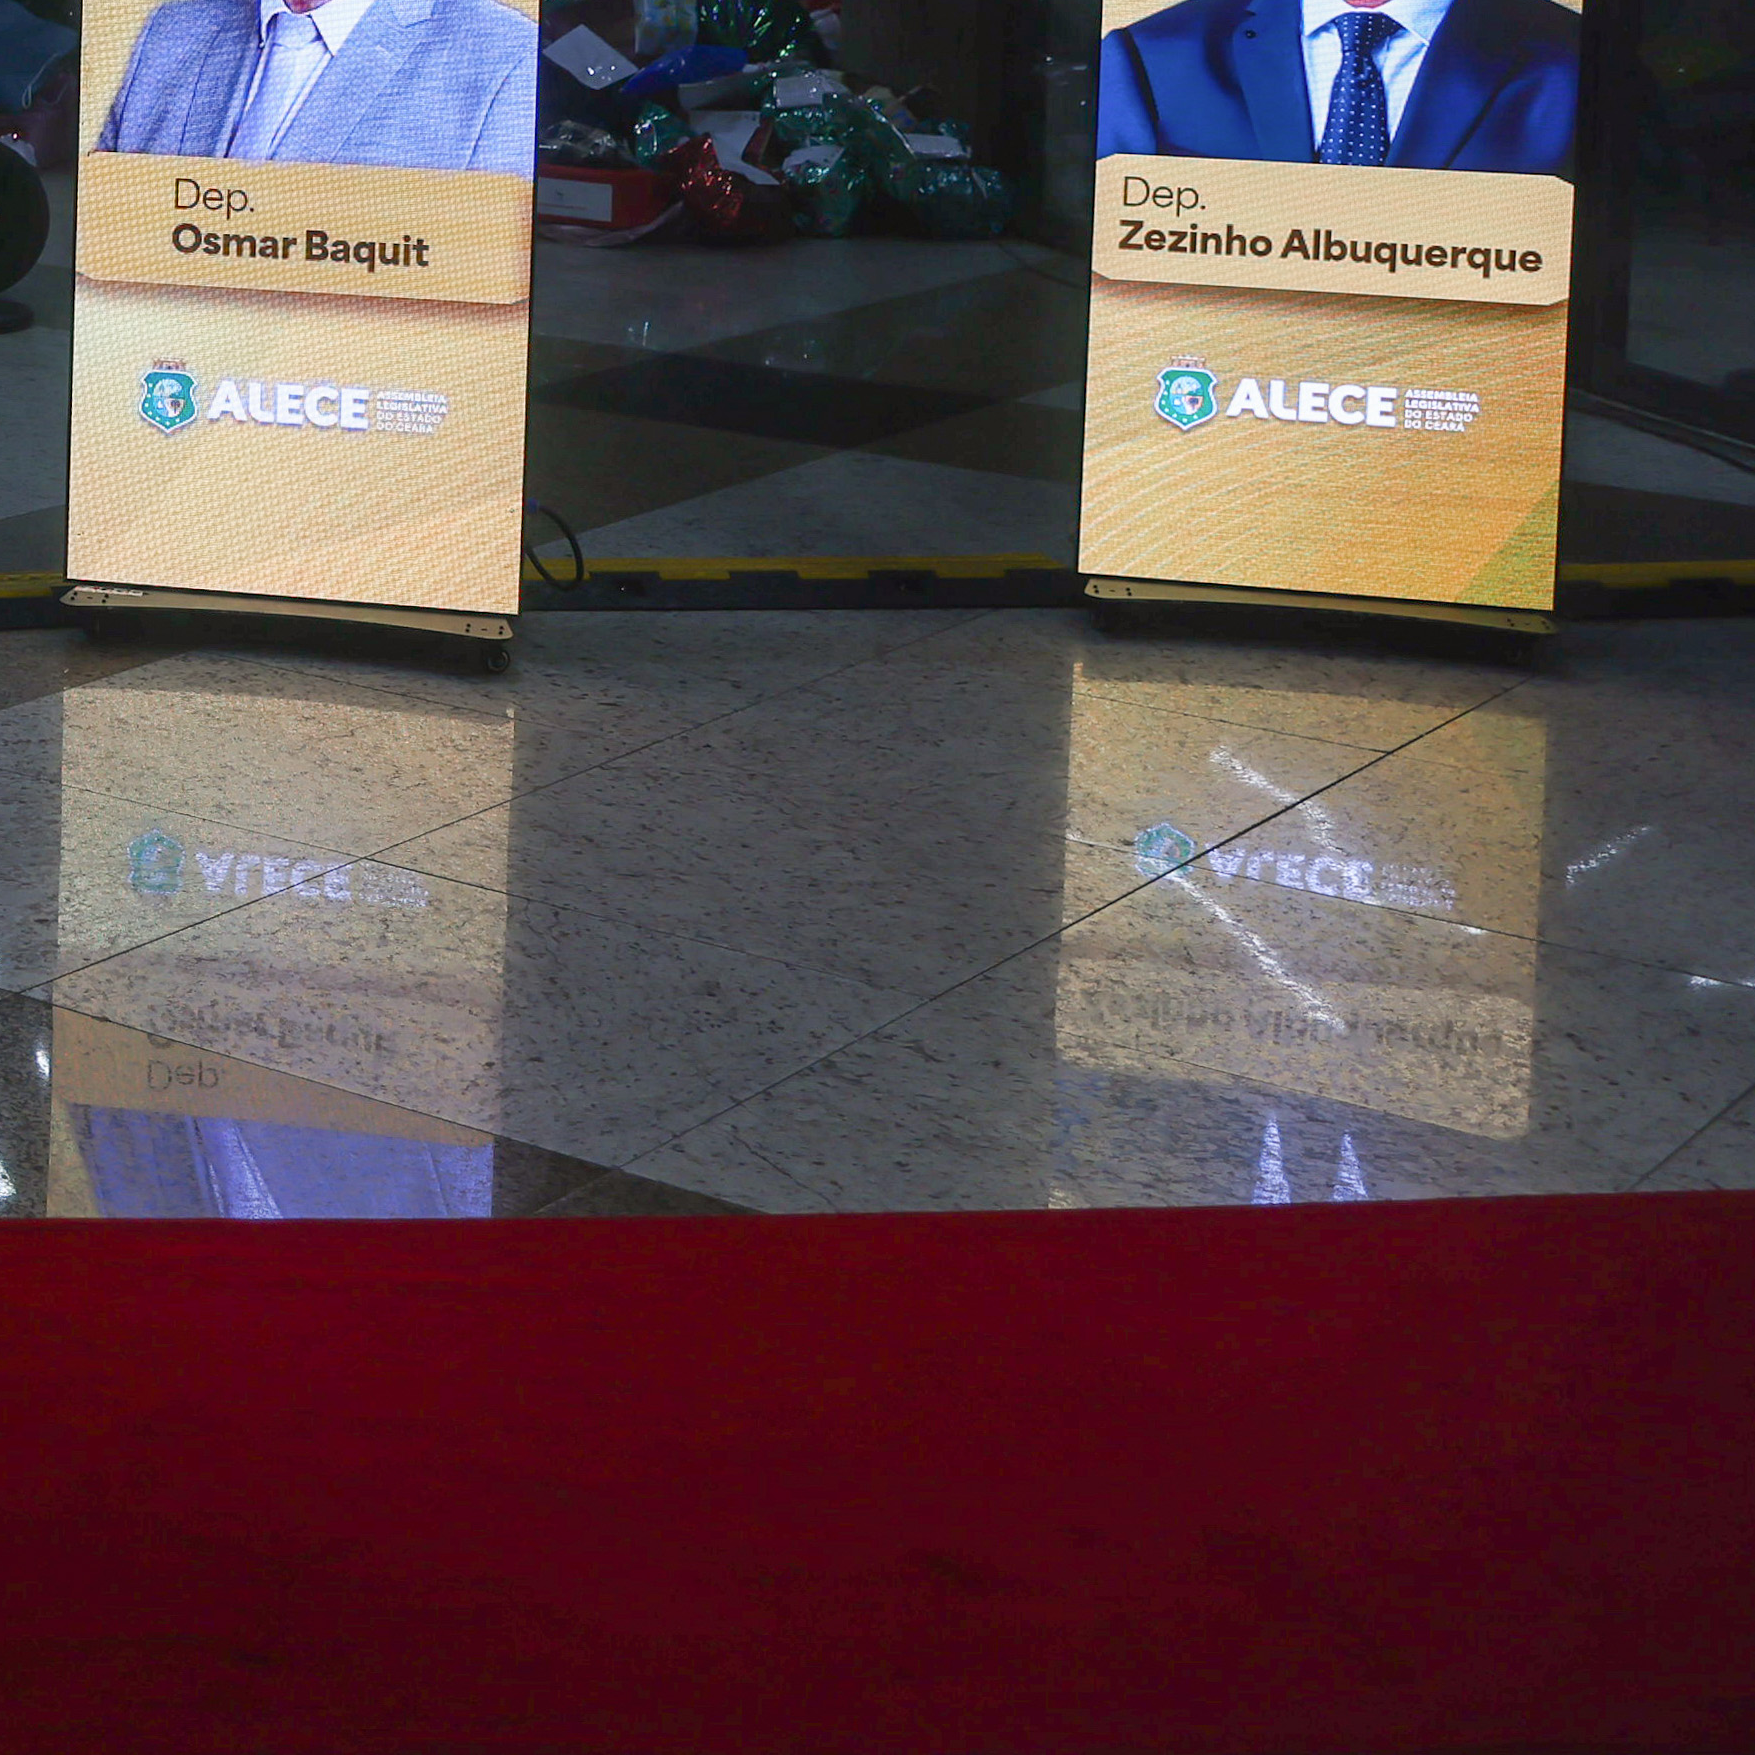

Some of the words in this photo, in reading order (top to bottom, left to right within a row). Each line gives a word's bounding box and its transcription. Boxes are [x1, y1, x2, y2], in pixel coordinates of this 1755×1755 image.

[174, 178, 255, 220] Dep.
[1122, 175, 1208, 218] Dep.
[171, 223, 298, 261] Osmar
[305, 229, 430, 273] Baquit
[1118, 218, 1273, 257] Zezinho
[1280, 227, 1544, 279] Albuquerque
[208, 379, 370, 431] ALECE
[377, 391, 448, 404] ASSEMBLEIA
[377, 401, 449, 414] LEGISLATIVA
[1226, 378, 1399, 428] ALECE
[1404, 389, 1479, 403] ASSEMBLEIA
[1404, 399, 1481, 413] LEGISLATIVA
[397, 412, 443, 424] ESTADO
[1425, 410, 1473, 422] ESTADO
